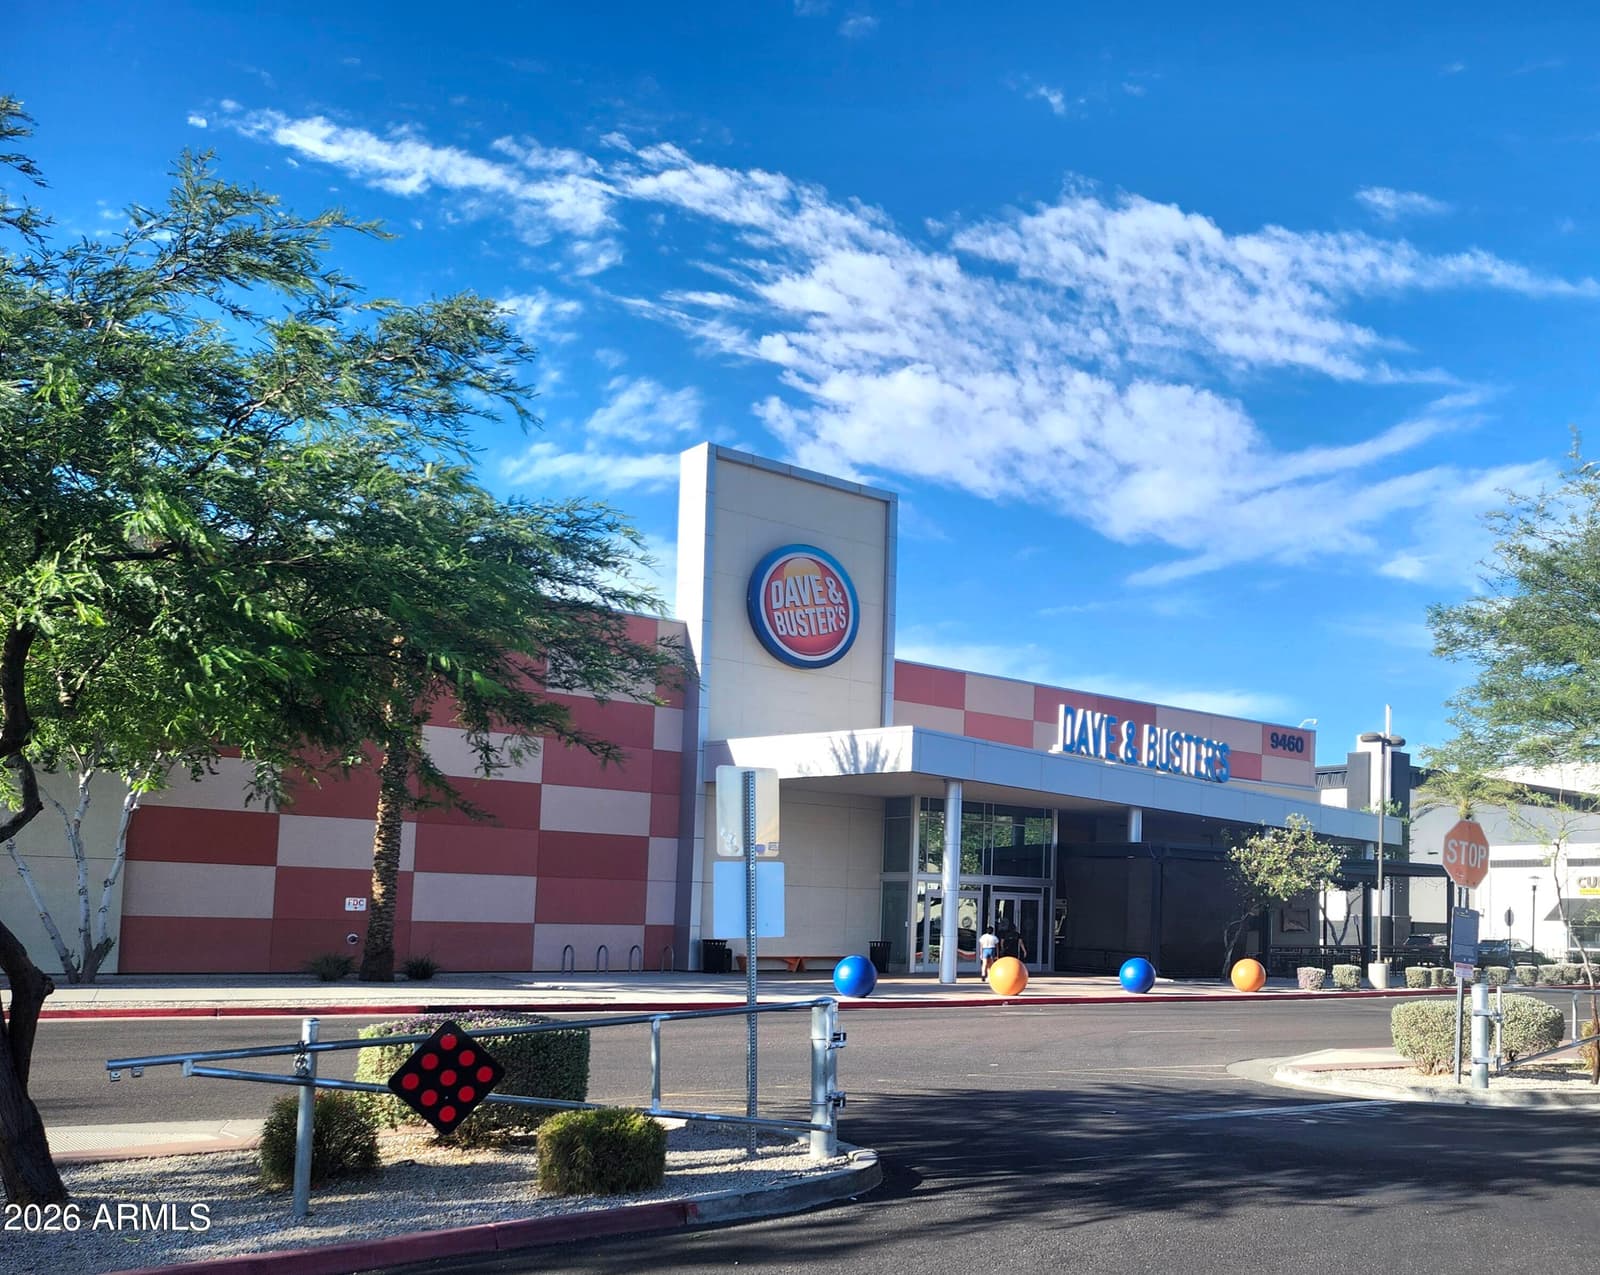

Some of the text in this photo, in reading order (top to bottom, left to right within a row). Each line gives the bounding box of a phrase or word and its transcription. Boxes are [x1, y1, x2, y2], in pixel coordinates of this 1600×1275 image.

[771, 575, 844, 610] DAVE &
[773, 606, 847, 638] BUSTER'S
[1059, 703, 1231, 784] DAVE & BUSTER'S
[1270, 732, 1304, 754] 9460
[1446, 839, 1487, 869] STOP
[1578, 875, 1600, 889] CU
